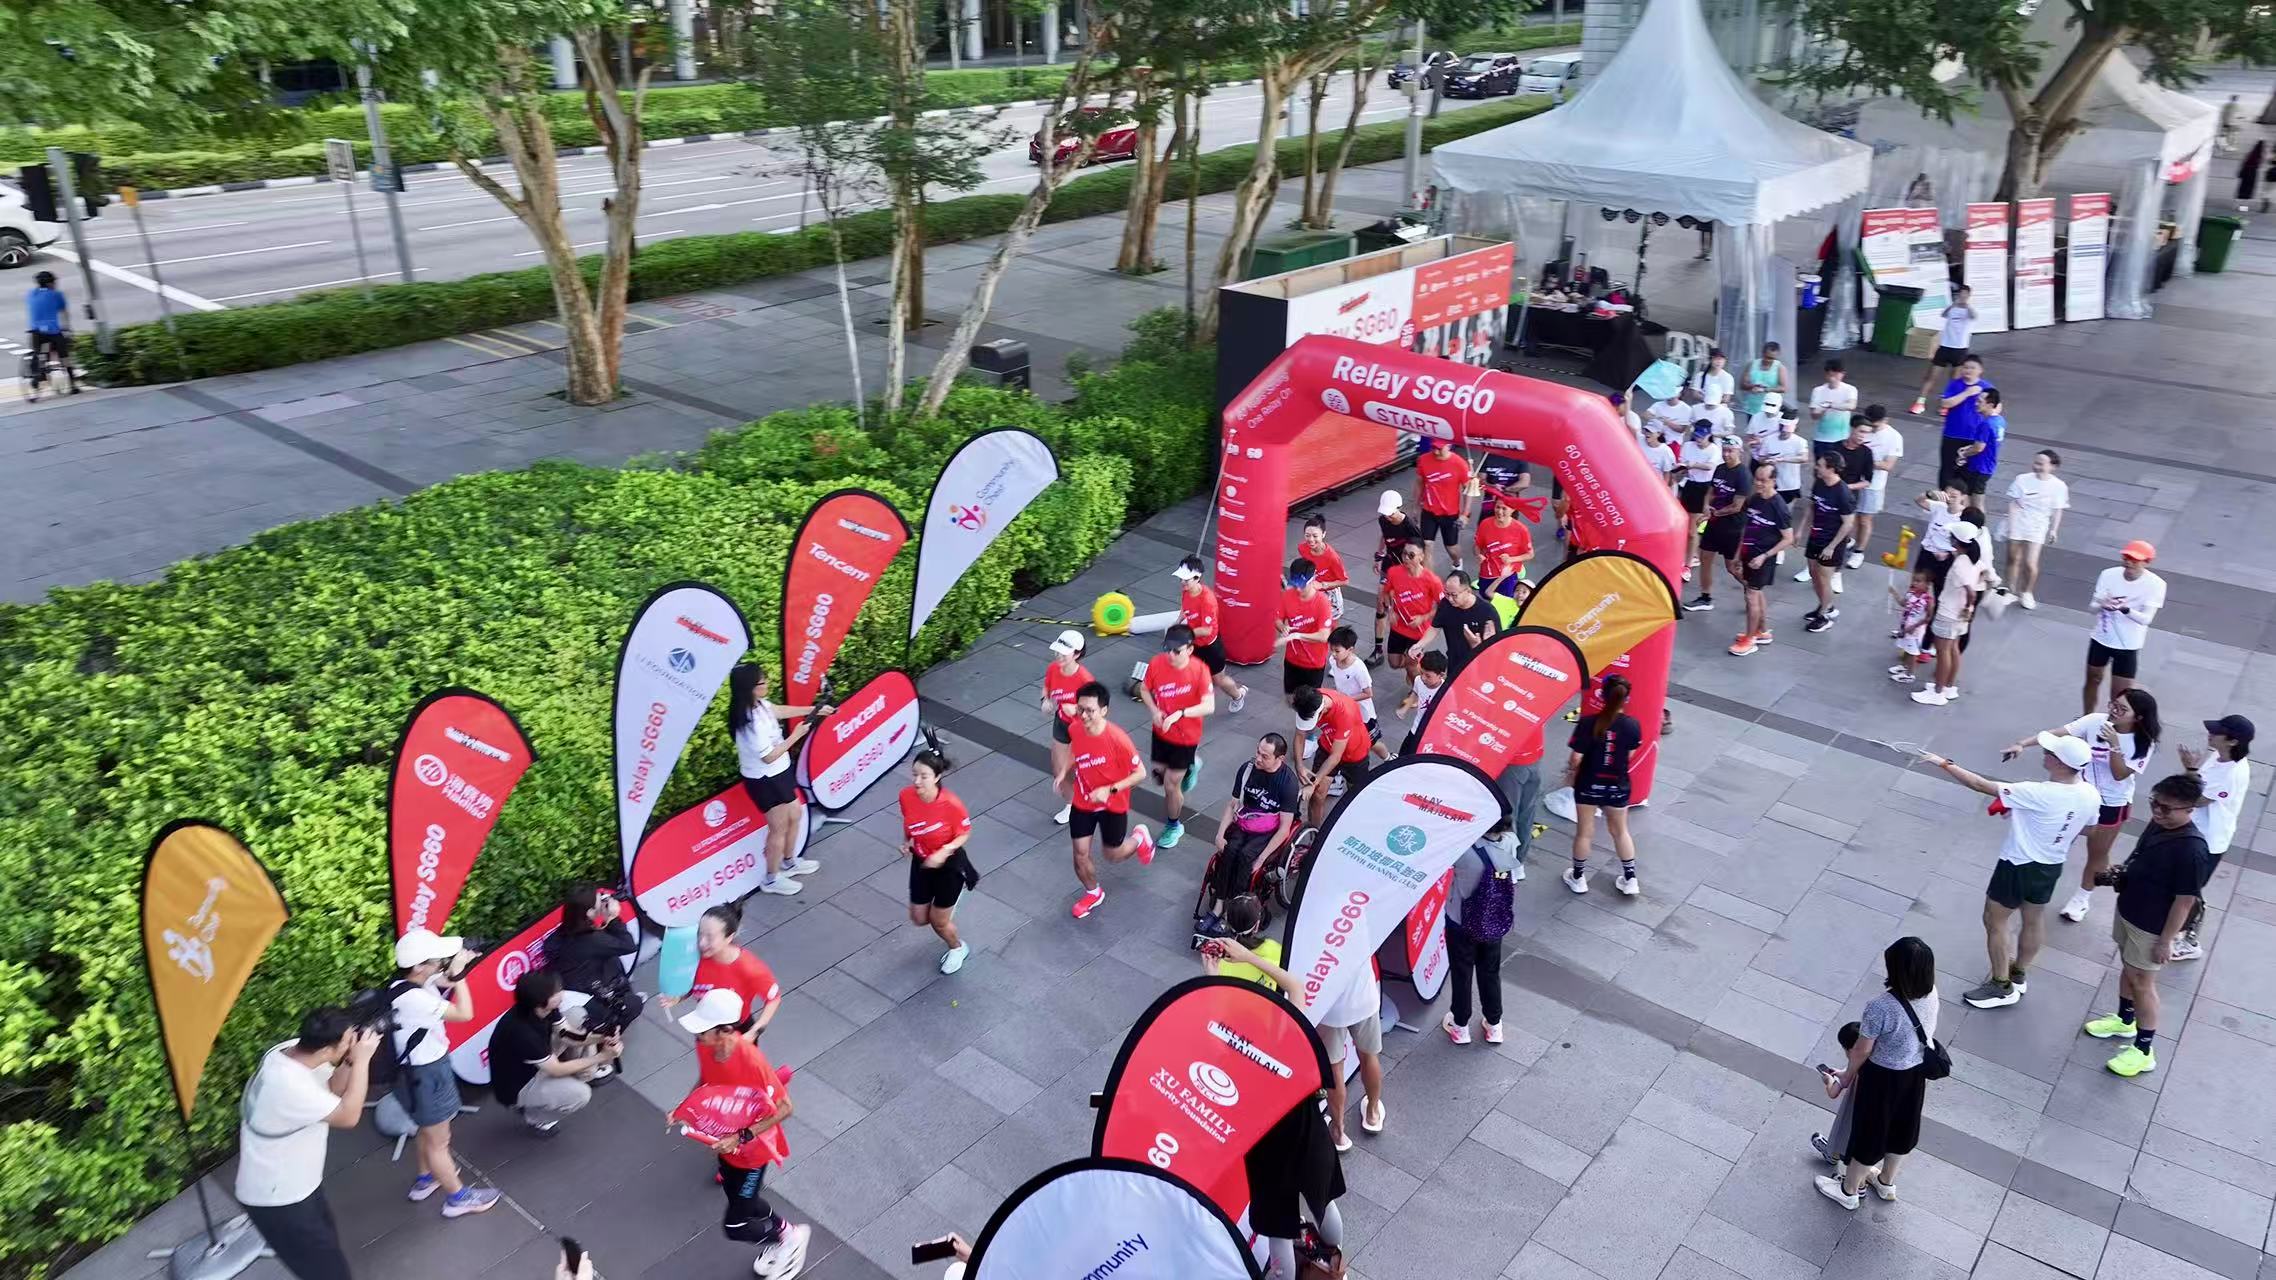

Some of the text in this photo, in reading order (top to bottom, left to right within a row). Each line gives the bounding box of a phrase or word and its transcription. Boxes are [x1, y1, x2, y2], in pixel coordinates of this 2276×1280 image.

[1332, 355, 1496, 414] Relay SG60
[1376, 407, 1440, 435] START
[1558, 460, 1609, 528] One Relay On
[1577, 460, 1601, 490] Years
[1596, 490, 1625, 526] Strong
[808, 542, 871, 582] Tencent
[793, 593, 834, 684] Relay SG60
[1566, 592, 1620, 633] Community
[832, 694, 887, 744] Tencent
[627, 702, 669, 803] Relay SG60
[829, 767, 856, 794] Relay
[416, 823, 446, 882] SG60
[667, 852, 756, 913] Relay SG60
[1325, 890, 1370, 948] SG60
[1217, 1022, 1253, 1046] RELAY
[1226, 1038, 1280, 1076] MAJULAH
[1149, 1076, 1181, 1105] Charity
[1179, 1104, 1228, 1144] Foundation
[1156, 1067, 1180, 1089] XU
[1179, 1087, 1237, 1136] FAMILY
